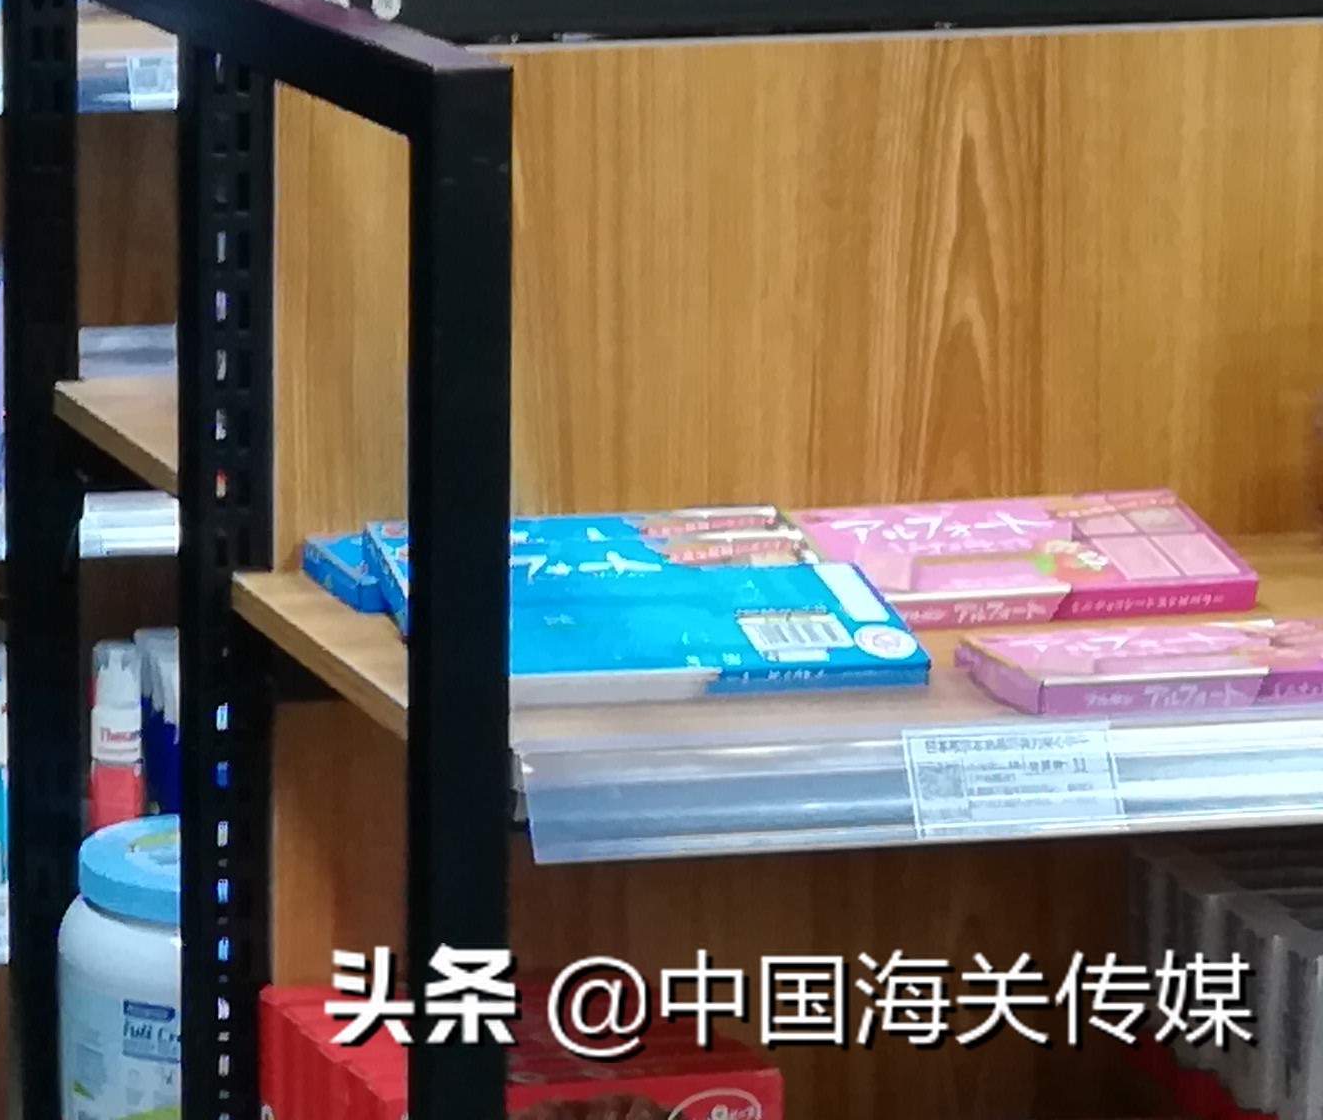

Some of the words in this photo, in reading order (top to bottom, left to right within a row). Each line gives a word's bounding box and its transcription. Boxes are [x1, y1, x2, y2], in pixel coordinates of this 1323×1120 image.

[830, 510, 1056, 545] アルフォート
